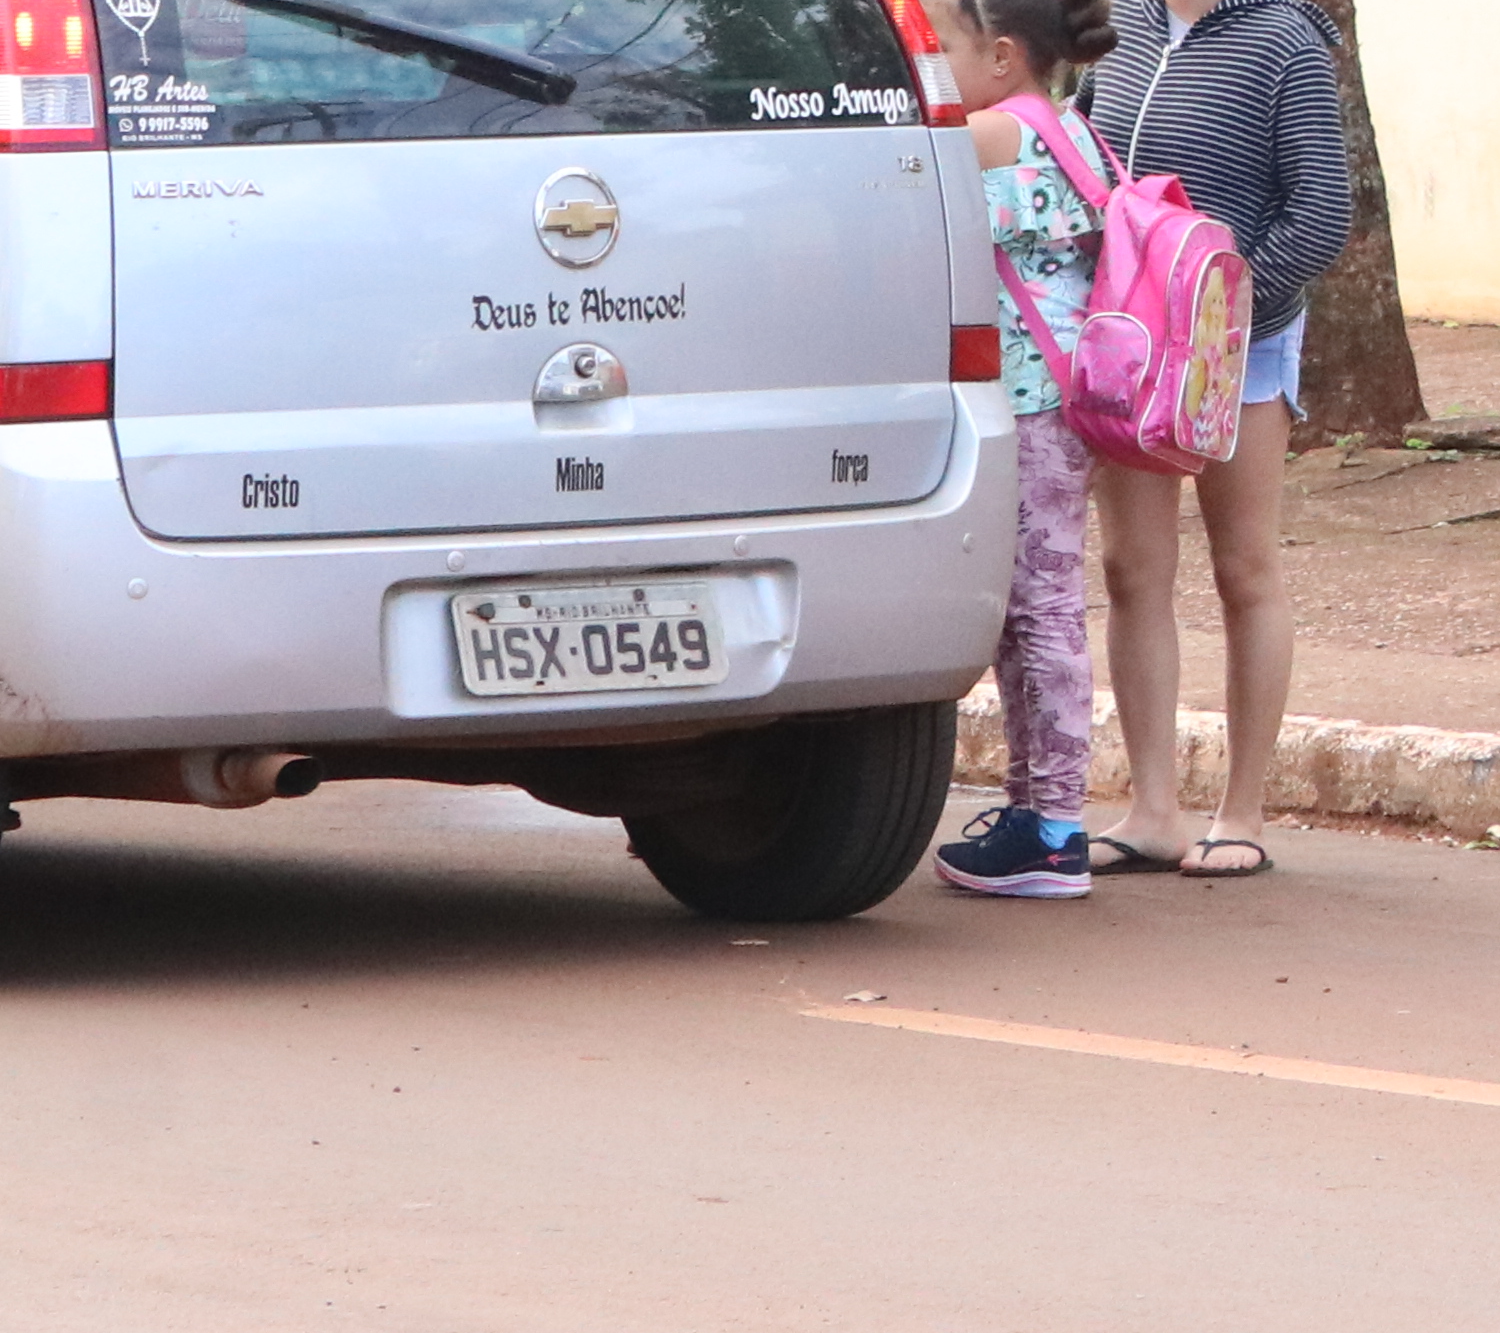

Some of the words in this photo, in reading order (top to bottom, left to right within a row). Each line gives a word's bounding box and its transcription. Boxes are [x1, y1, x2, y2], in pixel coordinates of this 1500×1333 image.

[109, 74, 149, 102] HB
[154, 74, 209, 103] Artes
[750, 86, 825, 121] Nosso
[831, 83, 909, 124] Amigo
[148, 116, 210, 132] 9917-5596
[132, 178, 265, 199] MERIVA
[471, 294, 537, 331] Deus
[548, 290, 570, 326] te
[580, 281, 687, 324] Abençoe!
[243, 473, 300, 509] Cristo
[556, 456, 605, 493] Minha
[831, 448, 869, 487] força
